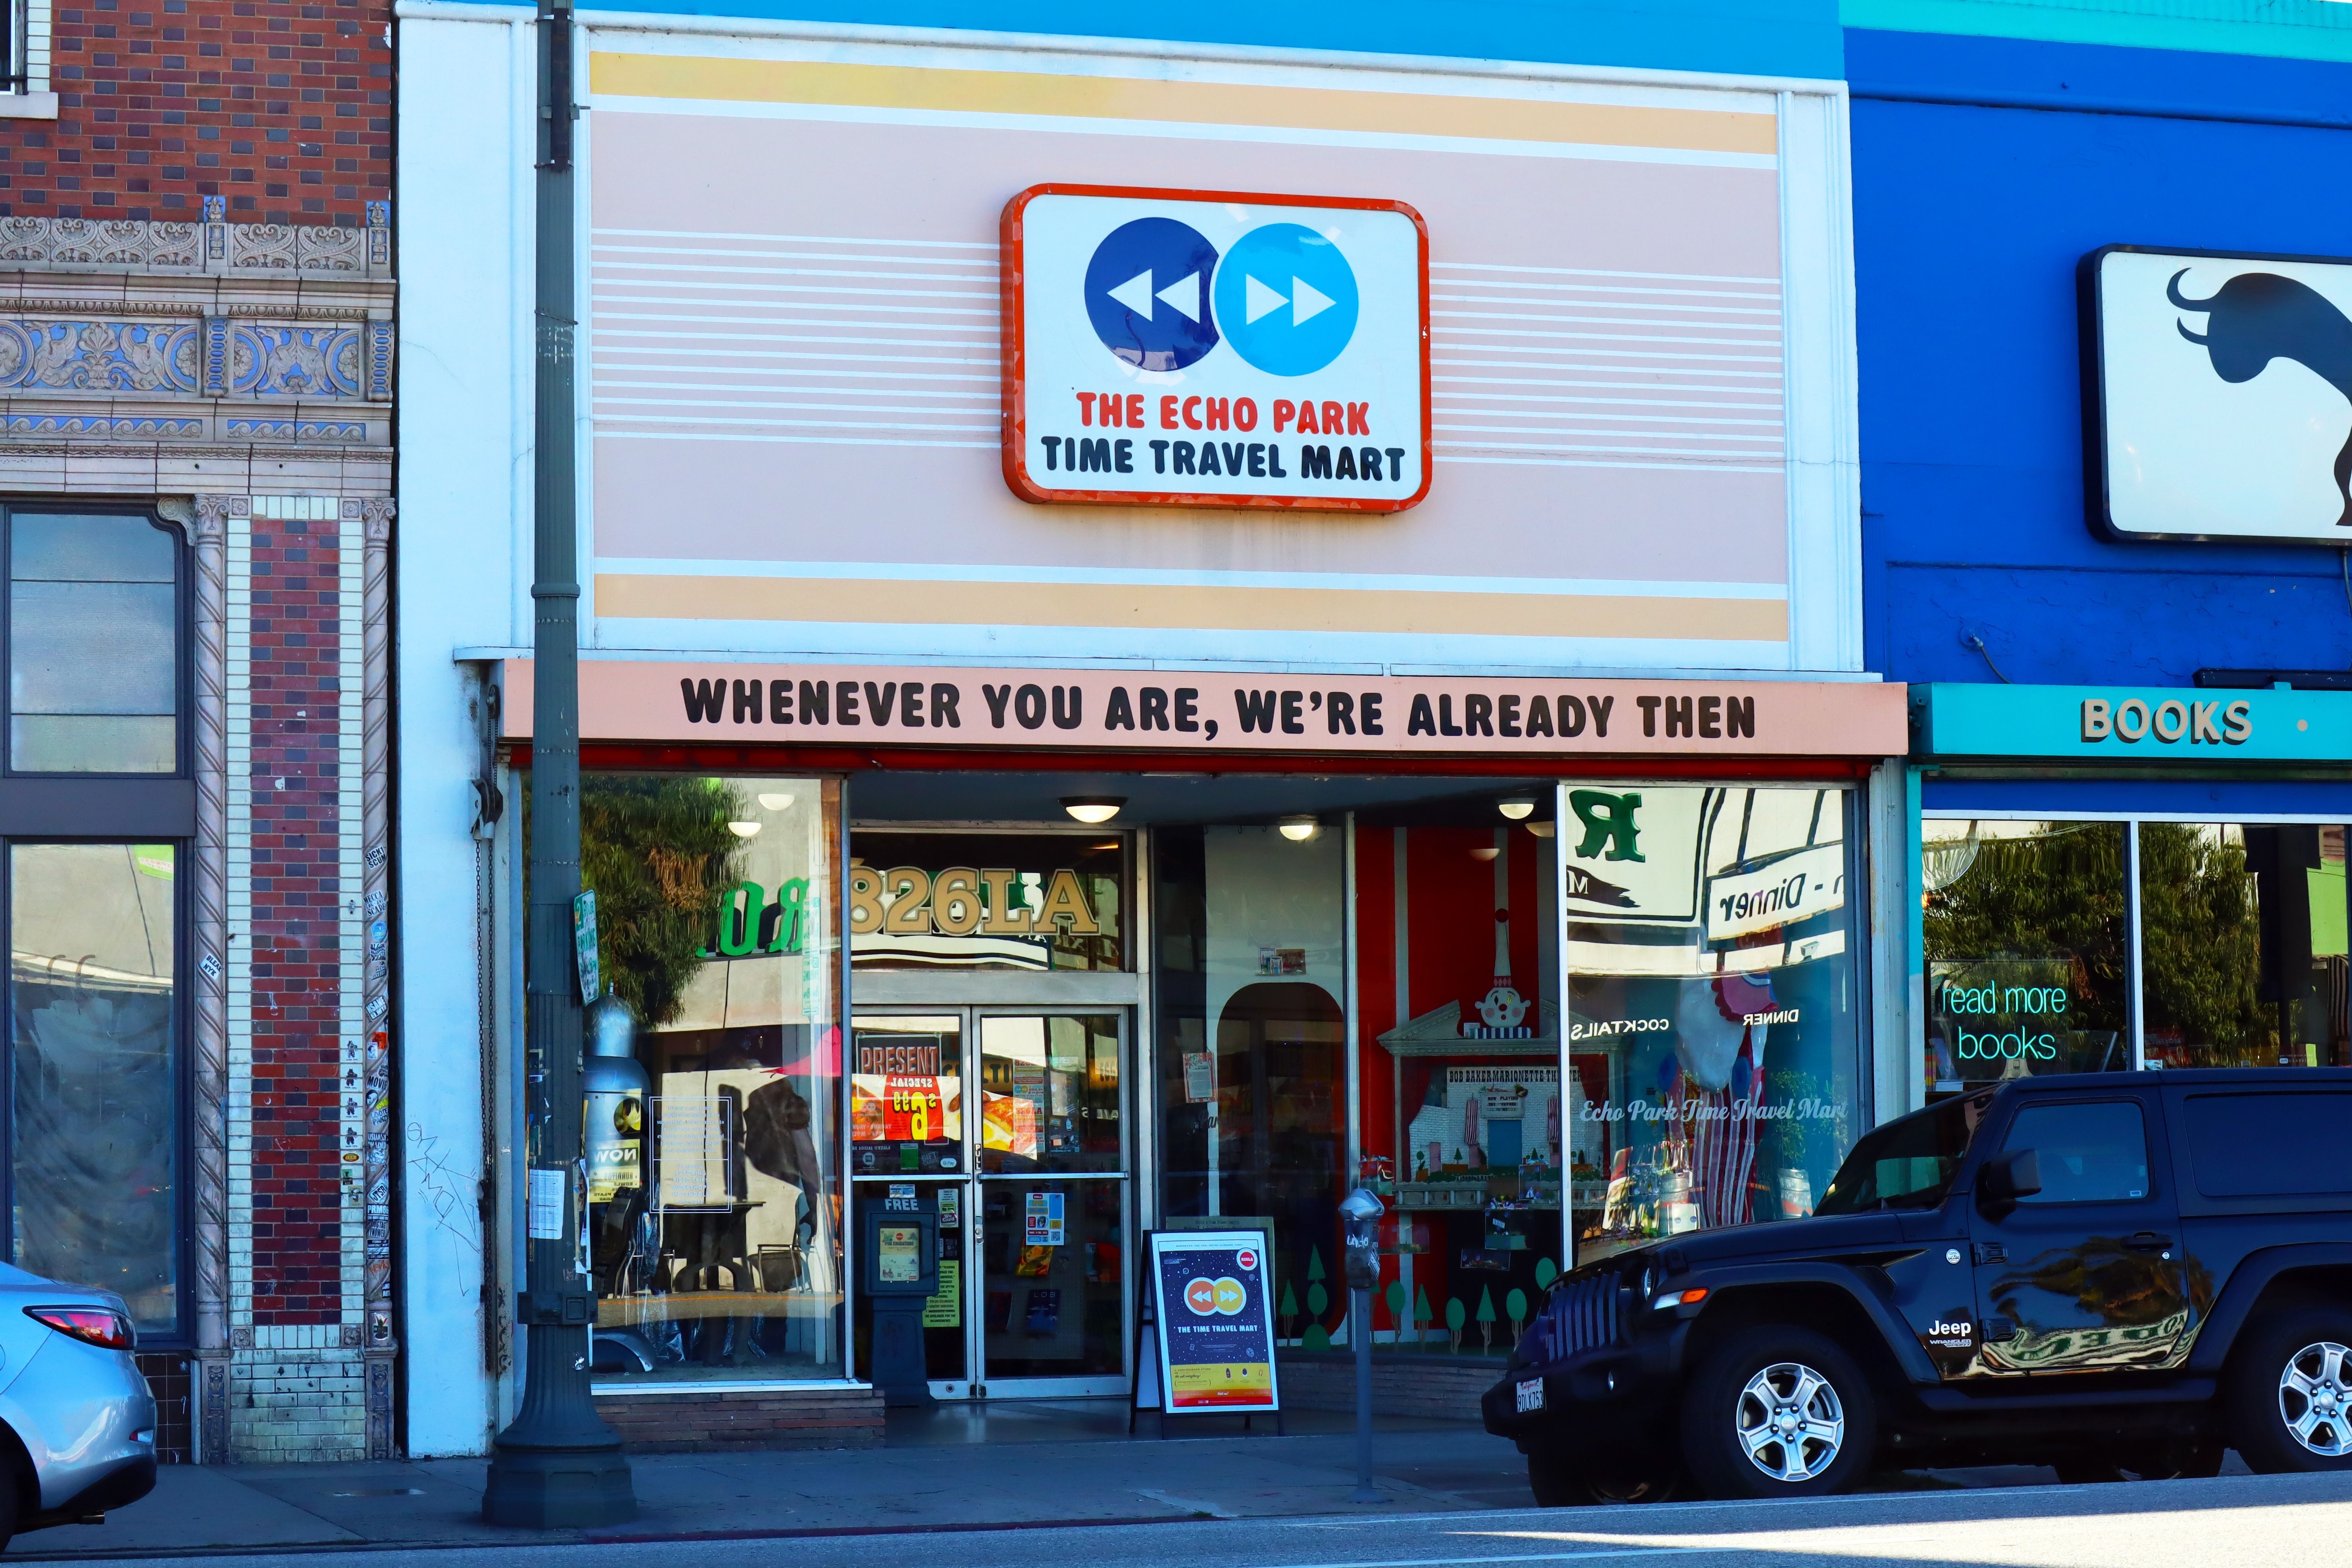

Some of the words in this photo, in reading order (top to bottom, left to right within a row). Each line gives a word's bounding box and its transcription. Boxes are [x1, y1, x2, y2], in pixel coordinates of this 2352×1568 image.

[1076, 392, 1144, 429] THE
[1160, 395, 1257, 432] ECHO
[1273, 399, 1370, 436] PARK
[1041, 436, 1133, 473] TIME
[1149, 439, 1287, 478] TRAVEL
[1301, 445, 1405, 482] MART
[681, 678, 961, 728] WHENEVER
[982, 683, 1082, 730] YOU
[1105, 686, 1218, 741] ARE,
[1234, 688, 1383, 735] WE'RE
[1406, 693, 1614, 738] ALREADY
[1636, 695, 1755, 739] THEN
[2081, 698, 2253, 745] BOOKS
[851, 866, 1101, 937] 826LA
[203, 964, 216, 976] NYK
[206, 955, 222, 972] BLEAK
[1942, 980, 1996, 1014] read
[2005, 986, 2067, 1014] more
[1958, 1026, 2056, 1060] books
[861, 1046, 938, 1074] PRESENT
[1450, 1070, 1463, 1083] BOB
[1466, 1070, 1491, 1083] BAKER
[1492, 1070, 1544, 1082] MARIONETTE
[1546, 1070, 1581, 1082] THTER
[1579, 1100, 1624, 1123] Echo
[1627, 1099, 1679, 1122] Park
[1681, 1098, 1730, 1122] Time
[1731, 1098, 1794, 1121] Travel
[1797, 1098, 1848, 1120] Mart
[885, 1198, 919, 1210] FREE
[1929, 1320, 1971, 1337] Jeep
[1518, 1390, 1543, 1412] 9DLK753
